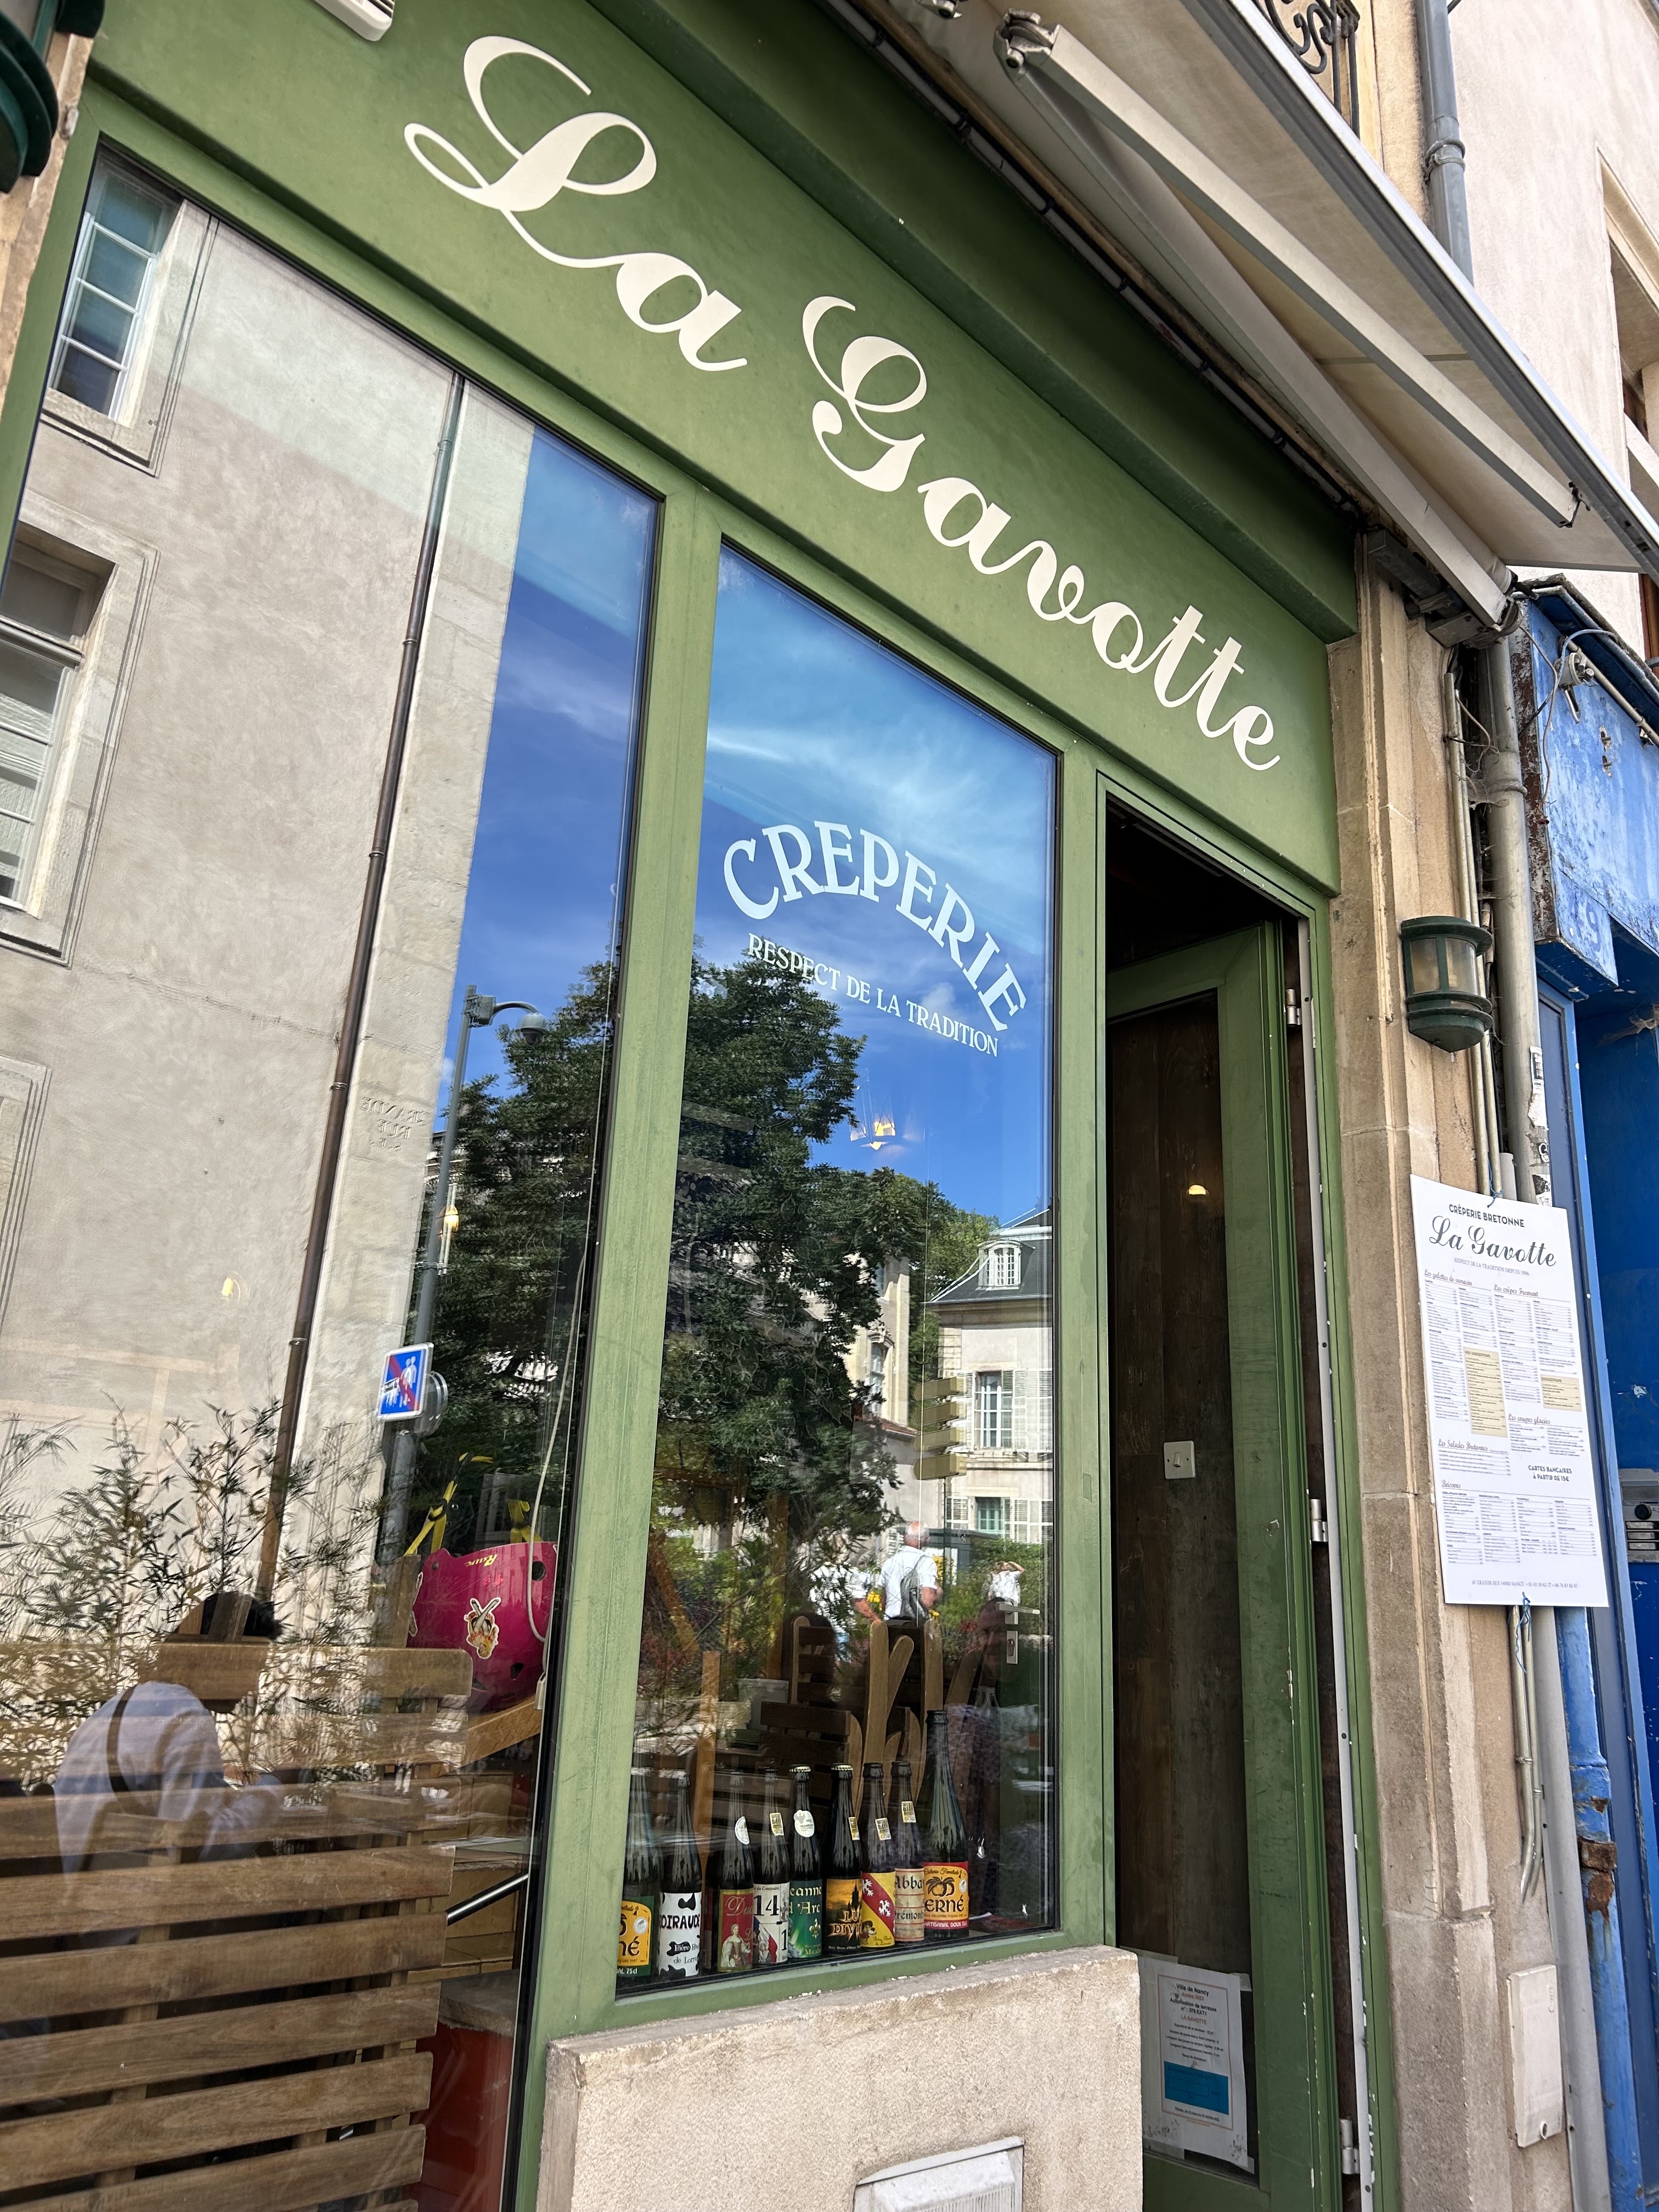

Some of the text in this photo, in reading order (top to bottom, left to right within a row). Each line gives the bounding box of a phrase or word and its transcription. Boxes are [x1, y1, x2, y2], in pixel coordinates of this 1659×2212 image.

[404, 35, 1280, 772] La Gavotte
[724, 820, 1027, 1031] CREPERIE
[748, 932, 998, 1057] RESPECT DE LA TRADITION
[1449, 1203, 1525, 1228] CRÊPERIE BRETONNE
[1429, 1216, 1557, 1267] La Gavotte
[1482, 1263, 1505, 1272] TRADITION
[1438, 1438, 1446, 1447] Les
[1447, 1439, 1465, 1449] Salades
[894, 1874, 924, 1889] Abba
[754, 1894, 779, 1916] 14
[660, 1914, 700, 1929] OIRAUD
[844, 1910, 862, 1922] LU
[1176, 1983, 1187, 1991] Ville
[1194, 1987, 1209, 1997] Nancy
[1170, 1997, 1194, 2007] Autorisation
[1187, 2016, 1207, 2025] GAVOTTE
